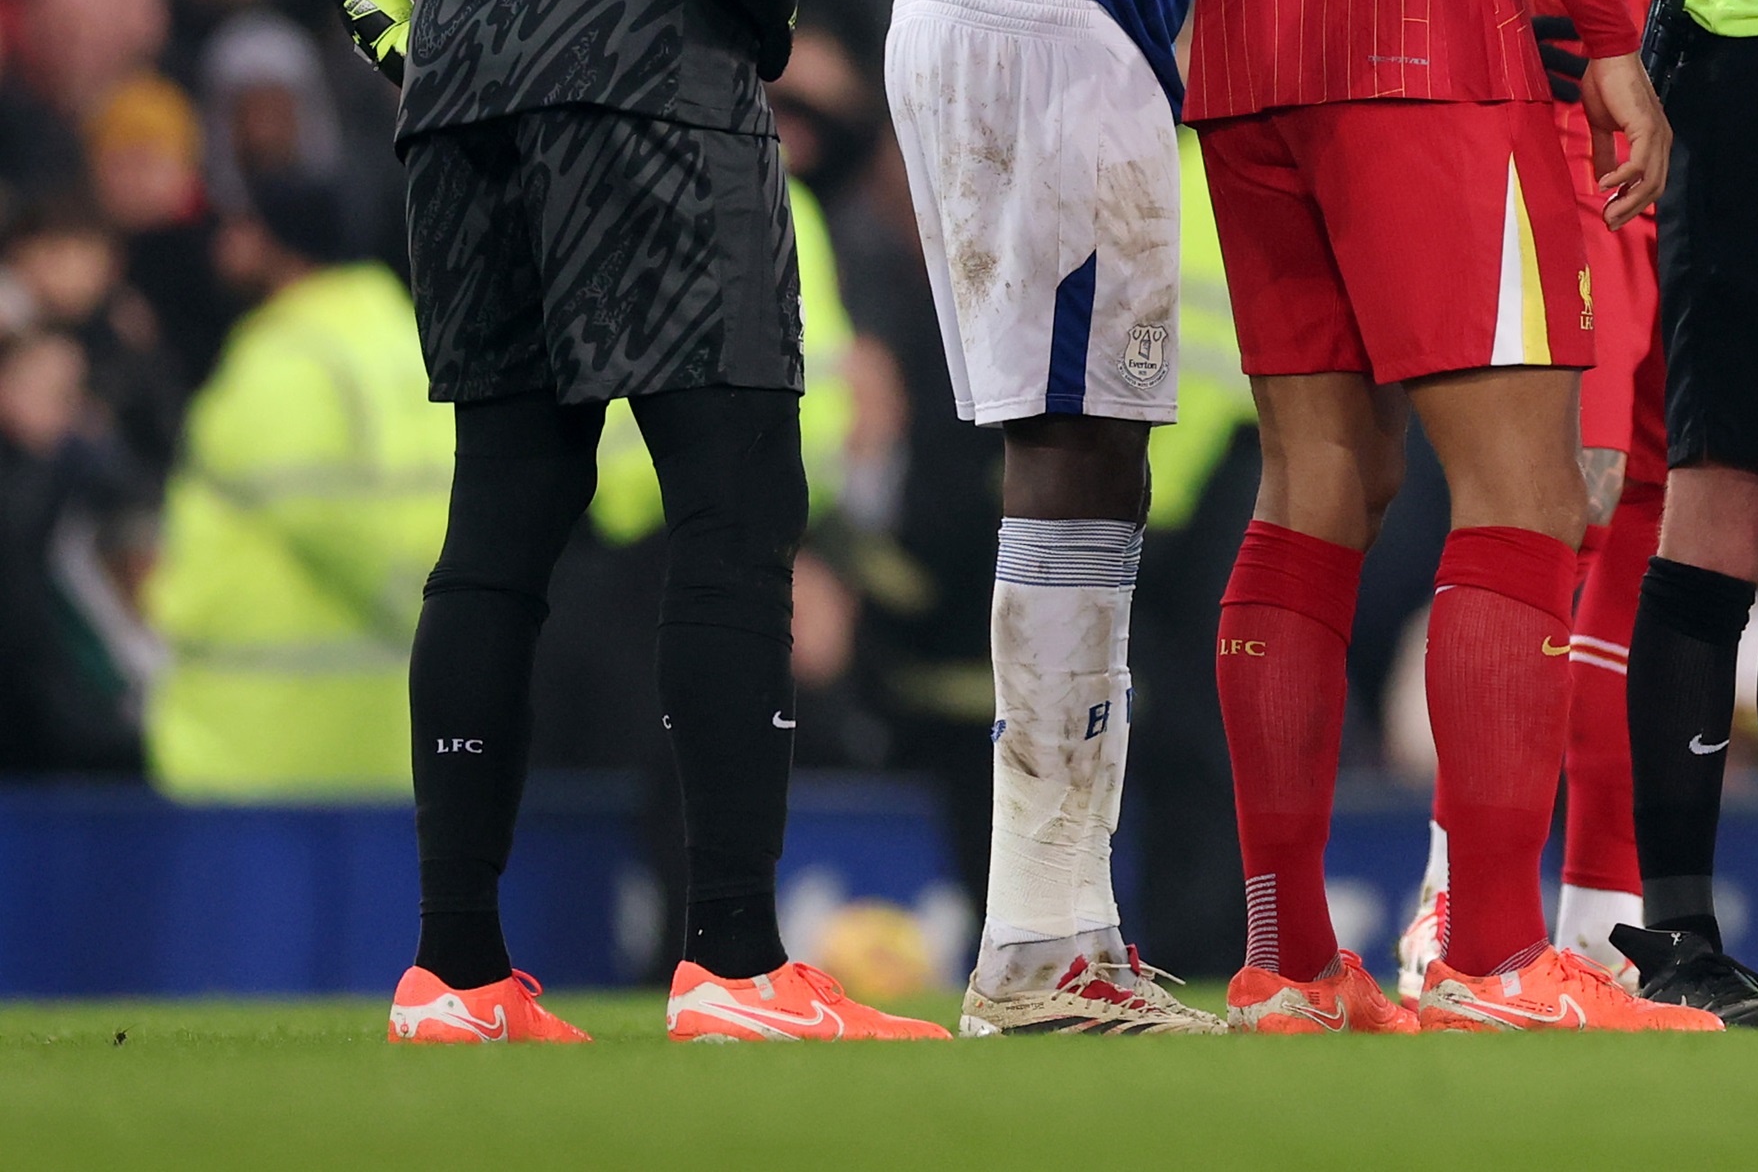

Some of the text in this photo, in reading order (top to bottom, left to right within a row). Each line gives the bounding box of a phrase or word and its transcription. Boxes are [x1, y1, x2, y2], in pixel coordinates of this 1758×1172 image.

[1128, 358, 1157, 370] Everton
[1219, 638, 1267, 657] LFC
[436, 738, 483, 754] LFC
